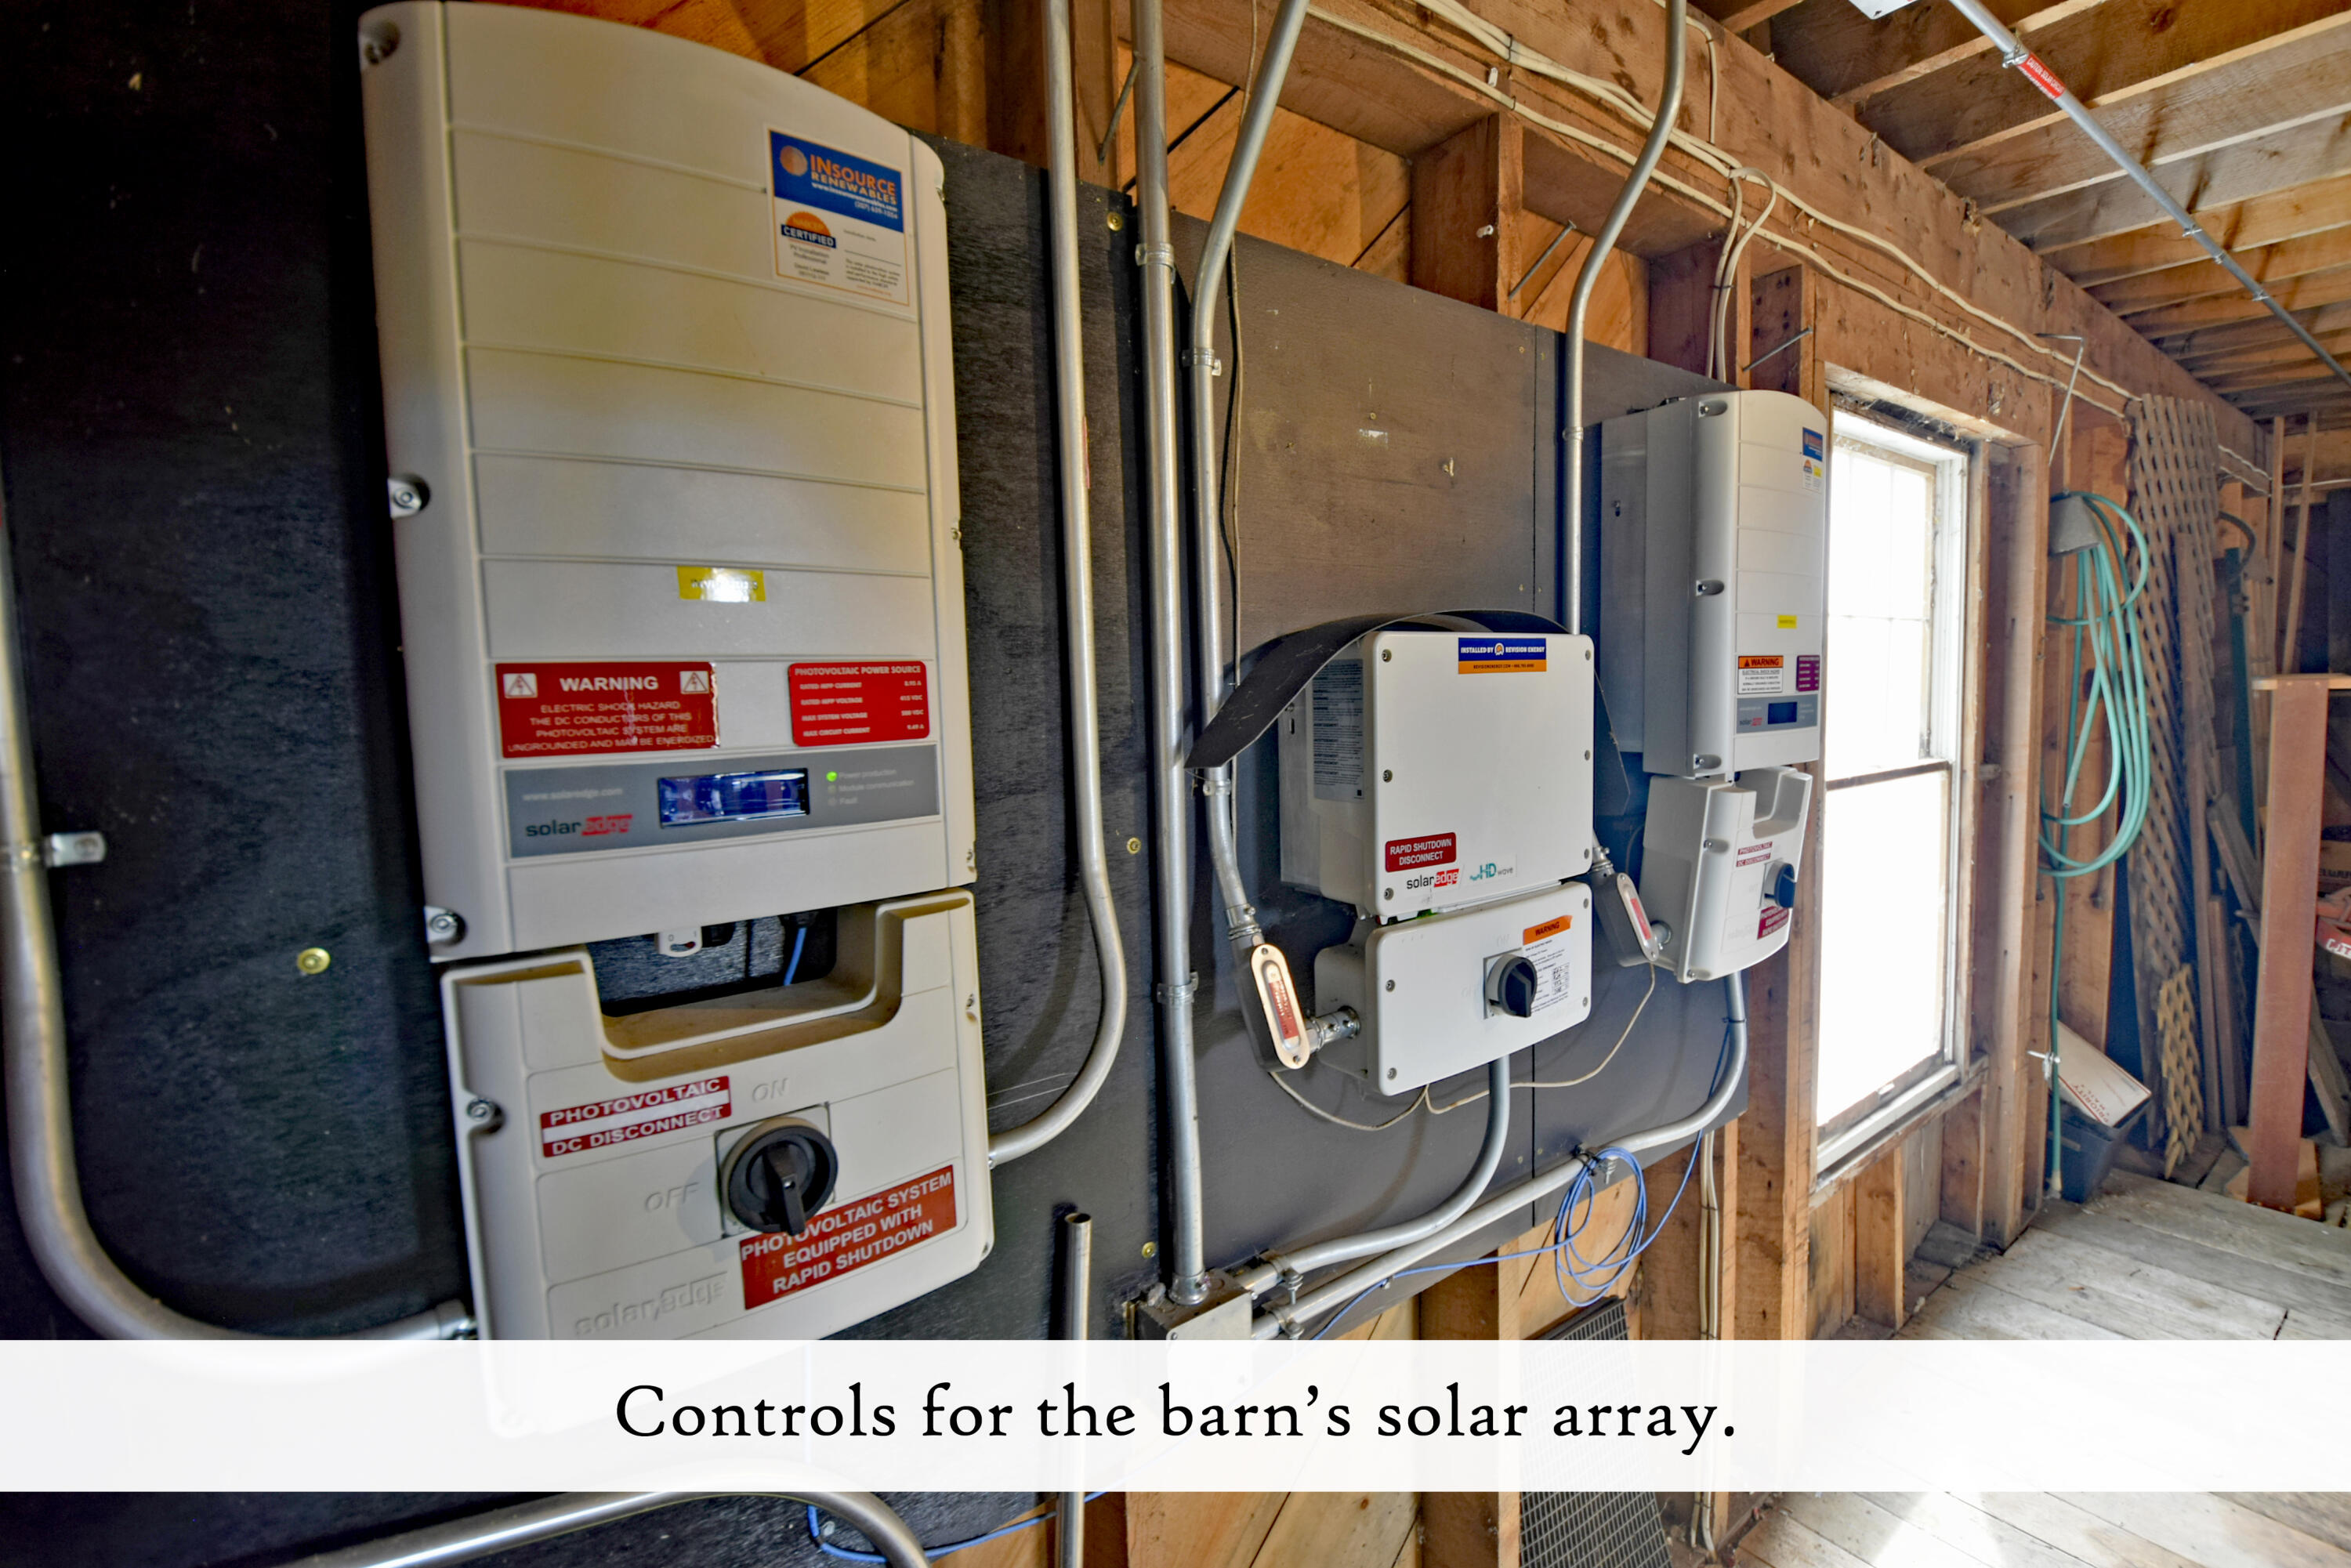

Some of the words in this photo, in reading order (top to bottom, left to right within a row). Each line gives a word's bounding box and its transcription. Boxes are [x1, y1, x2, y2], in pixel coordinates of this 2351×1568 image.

[810, 154, 896, 196] INSOURCE
[811, 171, 897, 205] RENEWABLES
[784, 226, 835, 247] CERTIFIED
[795, 667, 859, 676] PHOTOVOLTAIC
[861, 666, 889, 675] POWER
[891, 665, 922, 674] SOURCE
[1751, 657, 1780, 666] WARNING
[560, 675, 658, 692] WARNING
[541, 704, 594, 713] ELECTRIC
[598, 702, 636, 712] SHOCK
[638, 701, 680, 710] HAZARD
[530, 717, 551, 726] THE
[555, 716, 571, 726] DC
[652, 713, 665, 722] OF
[669, 712, 692, 721] THIS
[535, 726, 619, 738] PHOTOVOLTAIC
[622, 726, 665, 735] SYSTEM
[666, 724, 687, 733] ARE
[508, 740, 586, 752] UNGROUNDED
[589, 739, 614, 749] AND
[639, 737, 654, 746] BE
[656, 734, 715, 745] ENERGIZED
[1390, 844, 1412, 856] RAPID
[1414, 838, 1452, 851] SHUTDOWN
[1399, 851, 1444, 866] DISCONNECT
[1480, 863, 1497, 879] HD
[1535, 922, 1560, 936] WARNING
[752, 1078, 788, 1103] ON
[550, 1078, 720, 1127] PHOTOVOLTAIC
[552, 1138, 582, 1156] DC
[590, 1106, 723, 1147] DISCONNECT
[644, 1181, 700, 1212] OFF
[887, 1171, 952, 1208] SYSTEM
[784, 1222, 876, 1269] EQUIPPED
[880, 1204, 922, 1232] WITH
[773, 1261, 831, 1294] RAPID
[835, 1219, 933, 1270] SHUTDOWN
